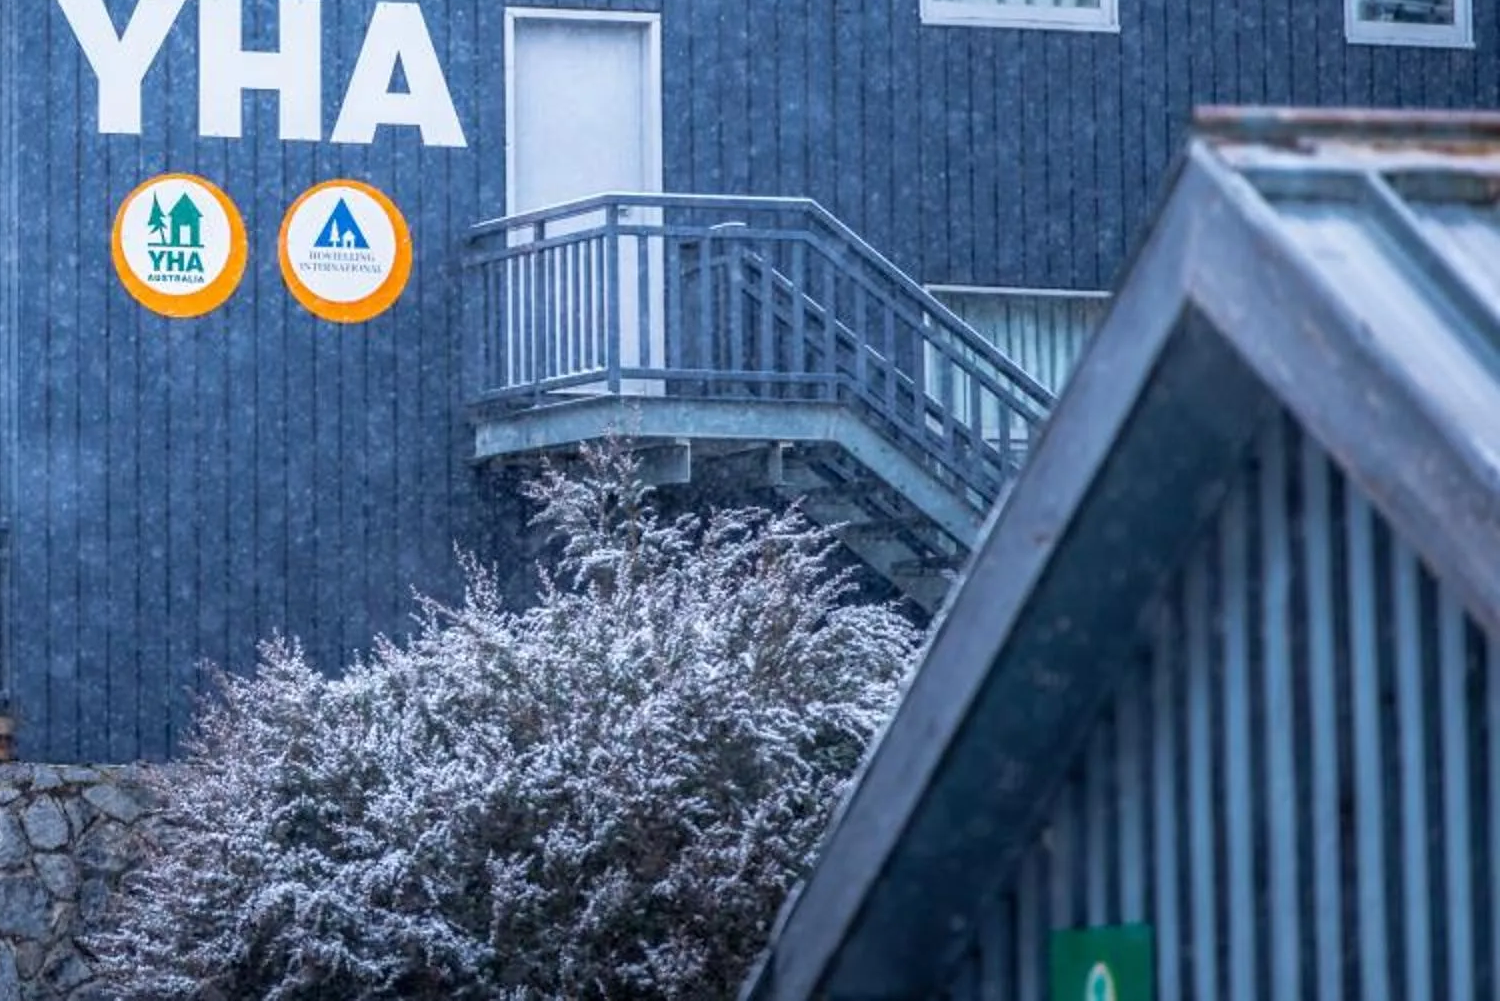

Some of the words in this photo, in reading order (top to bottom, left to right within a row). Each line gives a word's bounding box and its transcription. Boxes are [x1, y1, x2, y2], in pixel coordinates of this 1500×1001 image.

[148, 250, 204, 272] YHA
[299, 262, 382, 274] INTERNATIONAL
[147, 274, 204, 284] AUSTRALIA
